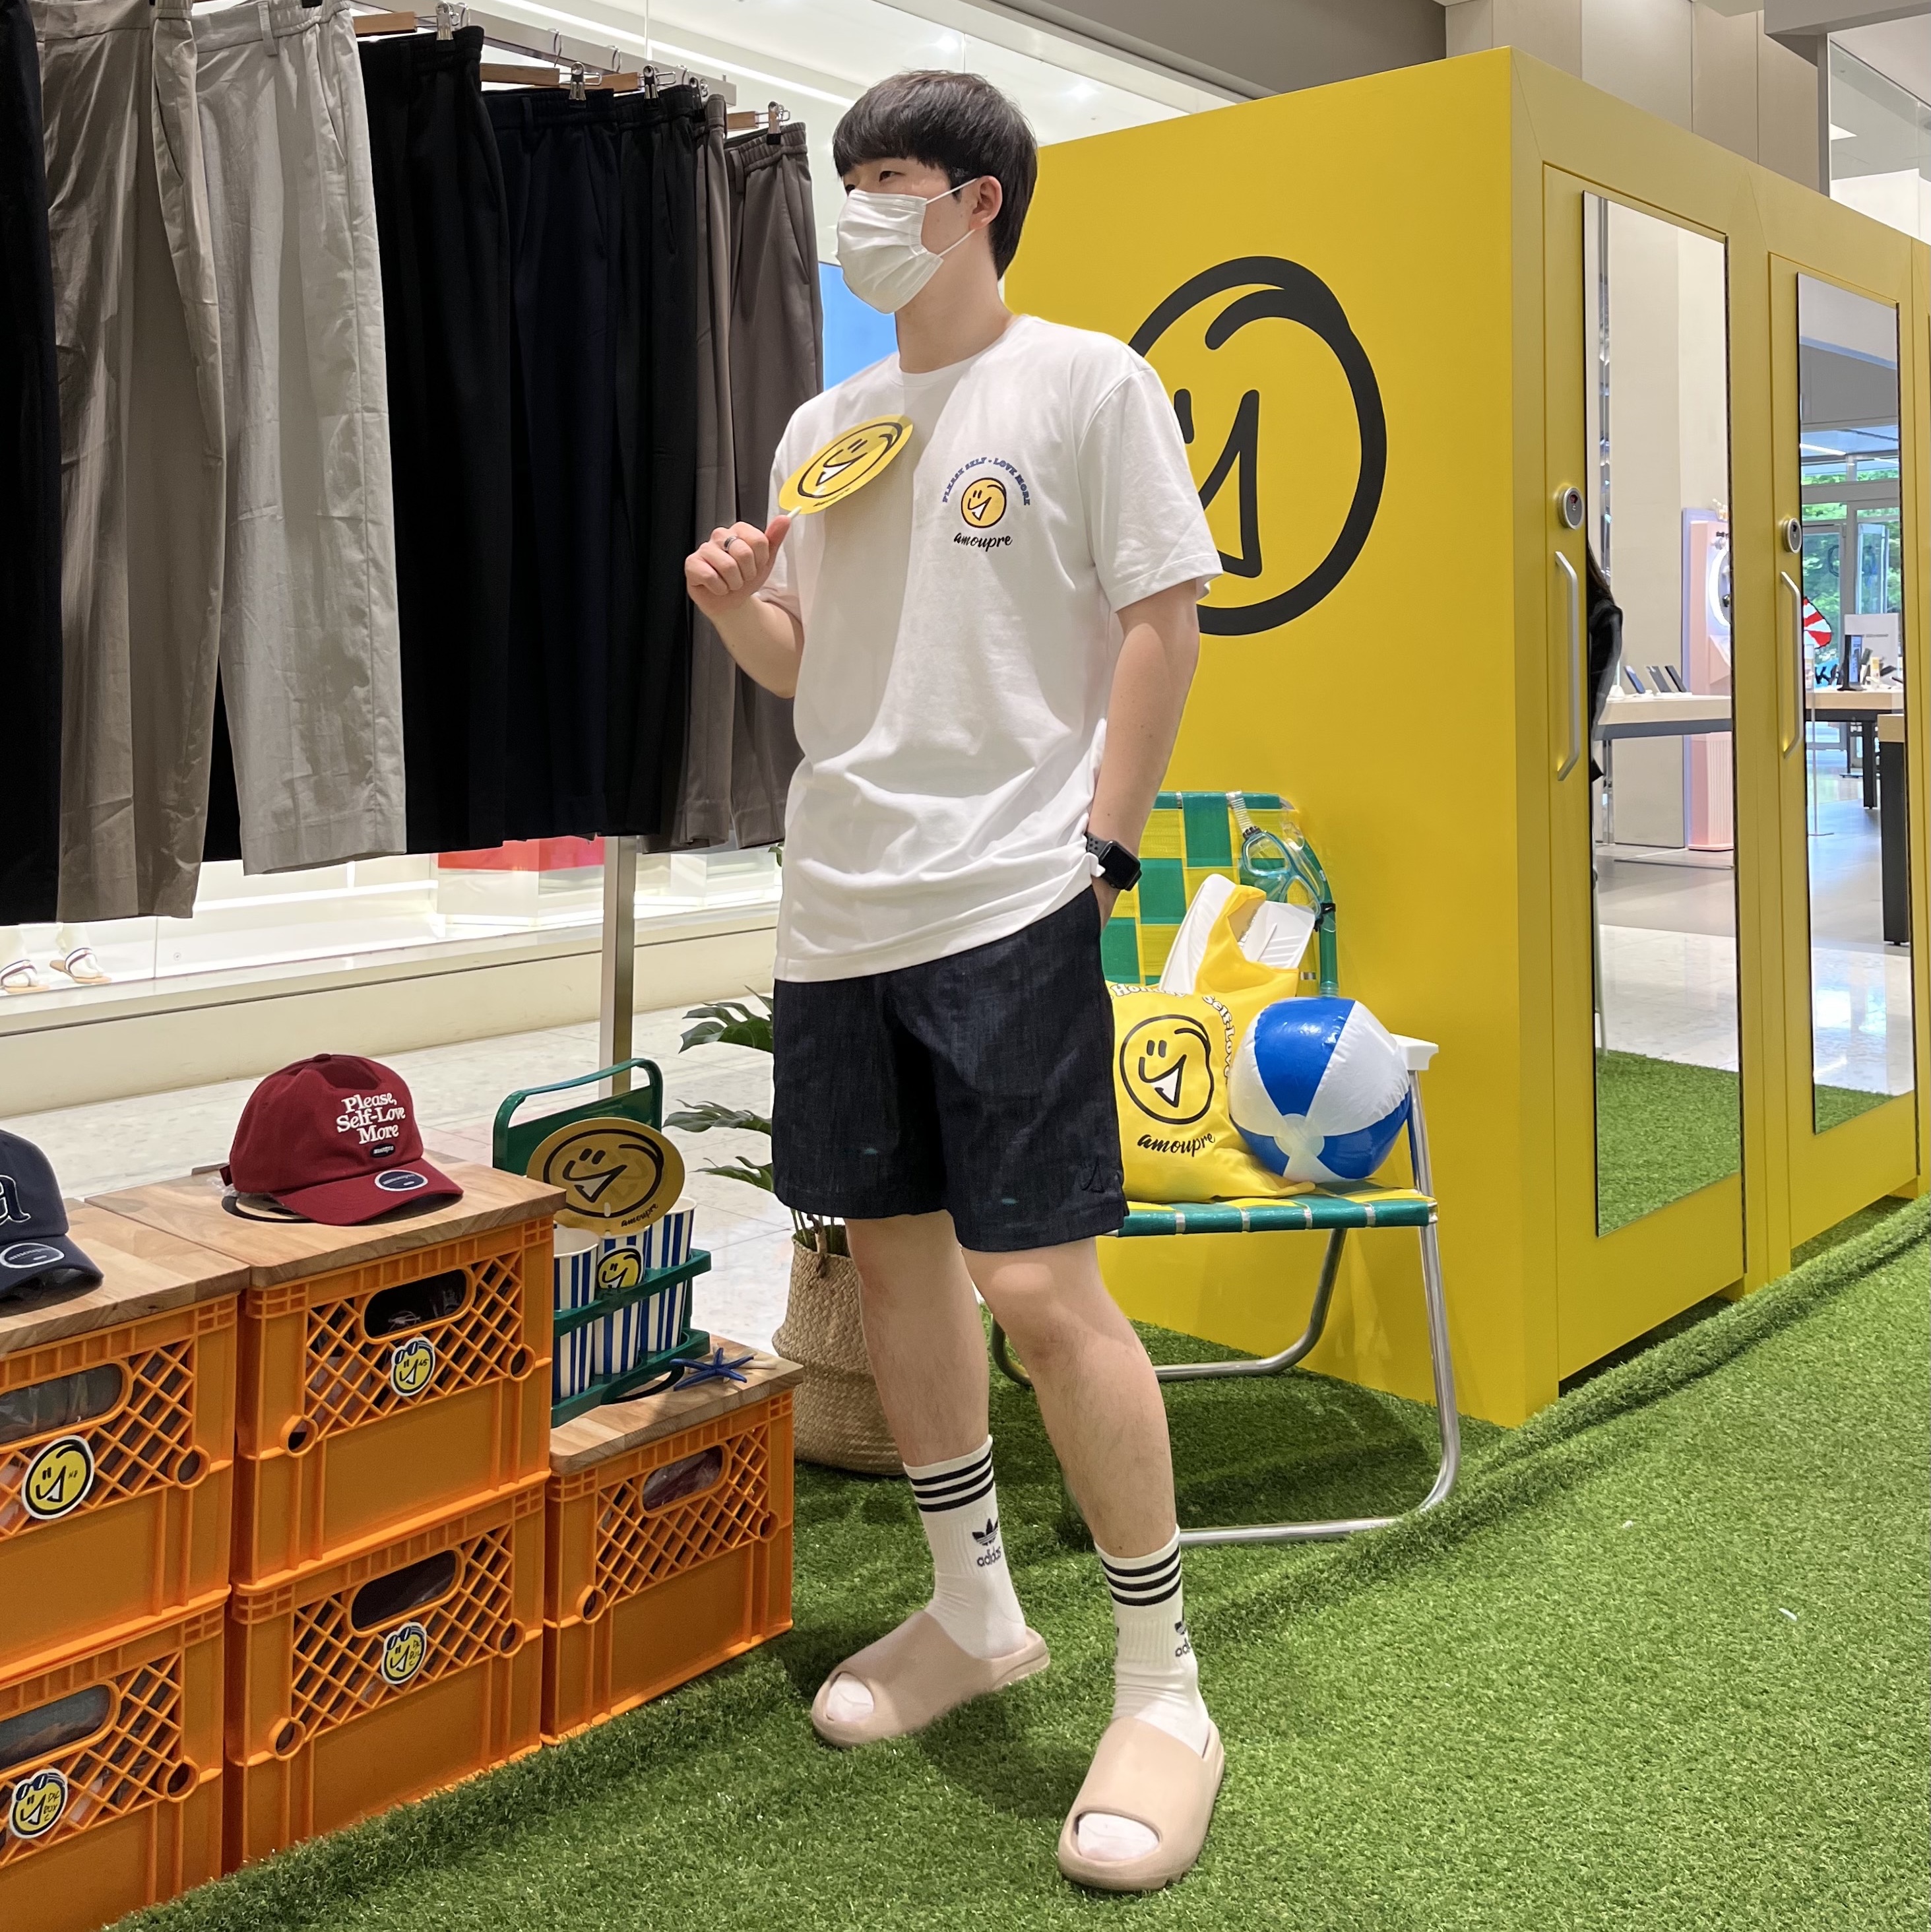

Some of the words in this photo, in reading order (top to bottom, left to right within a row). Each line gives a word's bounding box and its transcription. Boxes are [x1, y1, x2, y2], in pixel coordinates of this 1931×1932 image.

[942, 467, 965, 503] PLEASE
[965, 457, 987, 470] SELF
[994, 457, 1018, 476] LOVE
[1015, 474, 1031, 506] MORE
[953, 532, 1013, 552] amoupre
[341, 1092, 397, 1114] Please,
[336, 1107, 406, 1133] Self-Love
[356, 1124, 400, 1145] More
[1137, 1132, 1215, 1157] amoupre
